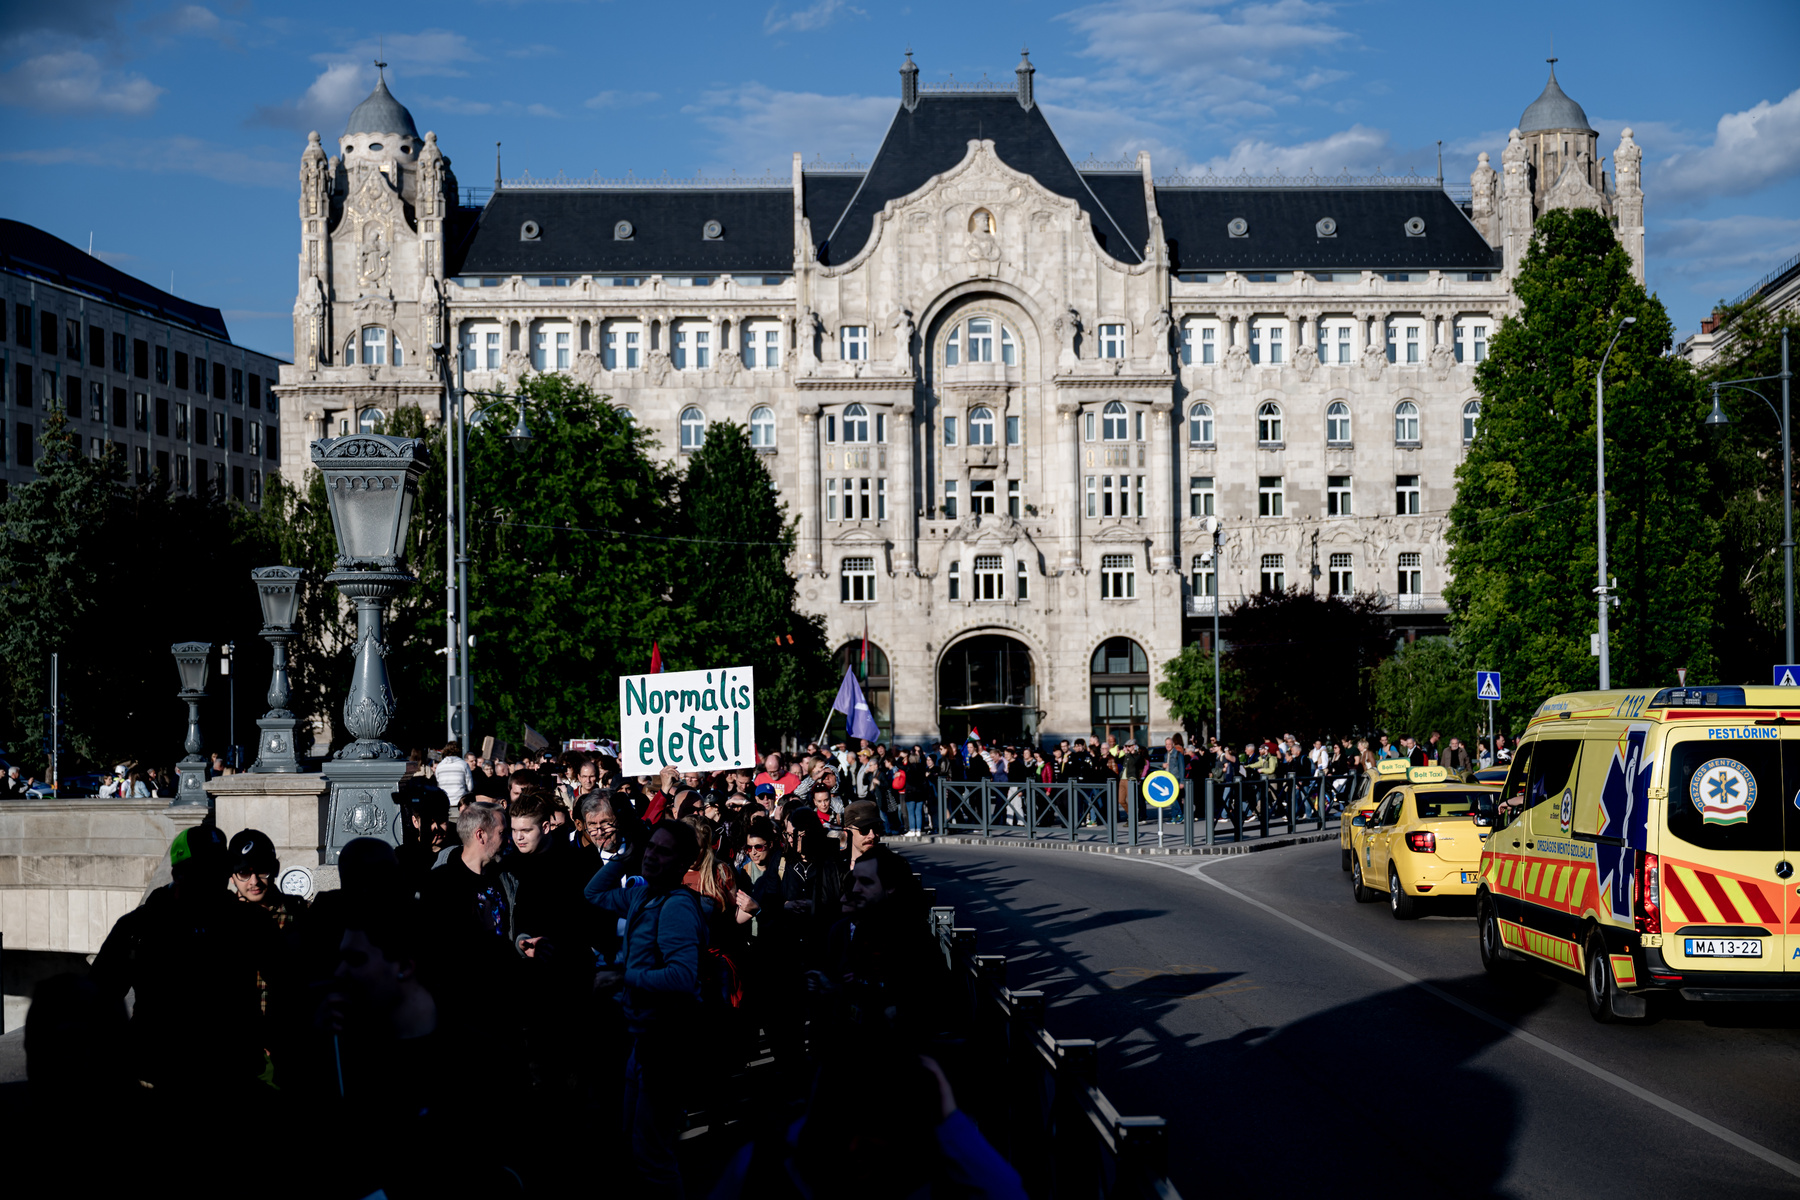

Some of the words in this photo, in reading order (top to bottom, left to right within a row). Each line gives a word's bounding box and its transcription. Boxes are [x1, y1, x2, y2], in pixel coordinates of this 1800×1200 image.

[626, 670, 750, 716] Normális
[639, 711, 741, 767] életet!
[1708, 725, 1777, 739] PESTLŐRINC
[1692, 767, 1707, 808] ORSZÁGOS
[1696, 941, 1715, 953] MA
[1720, 941, 1758, 953] 13-22
